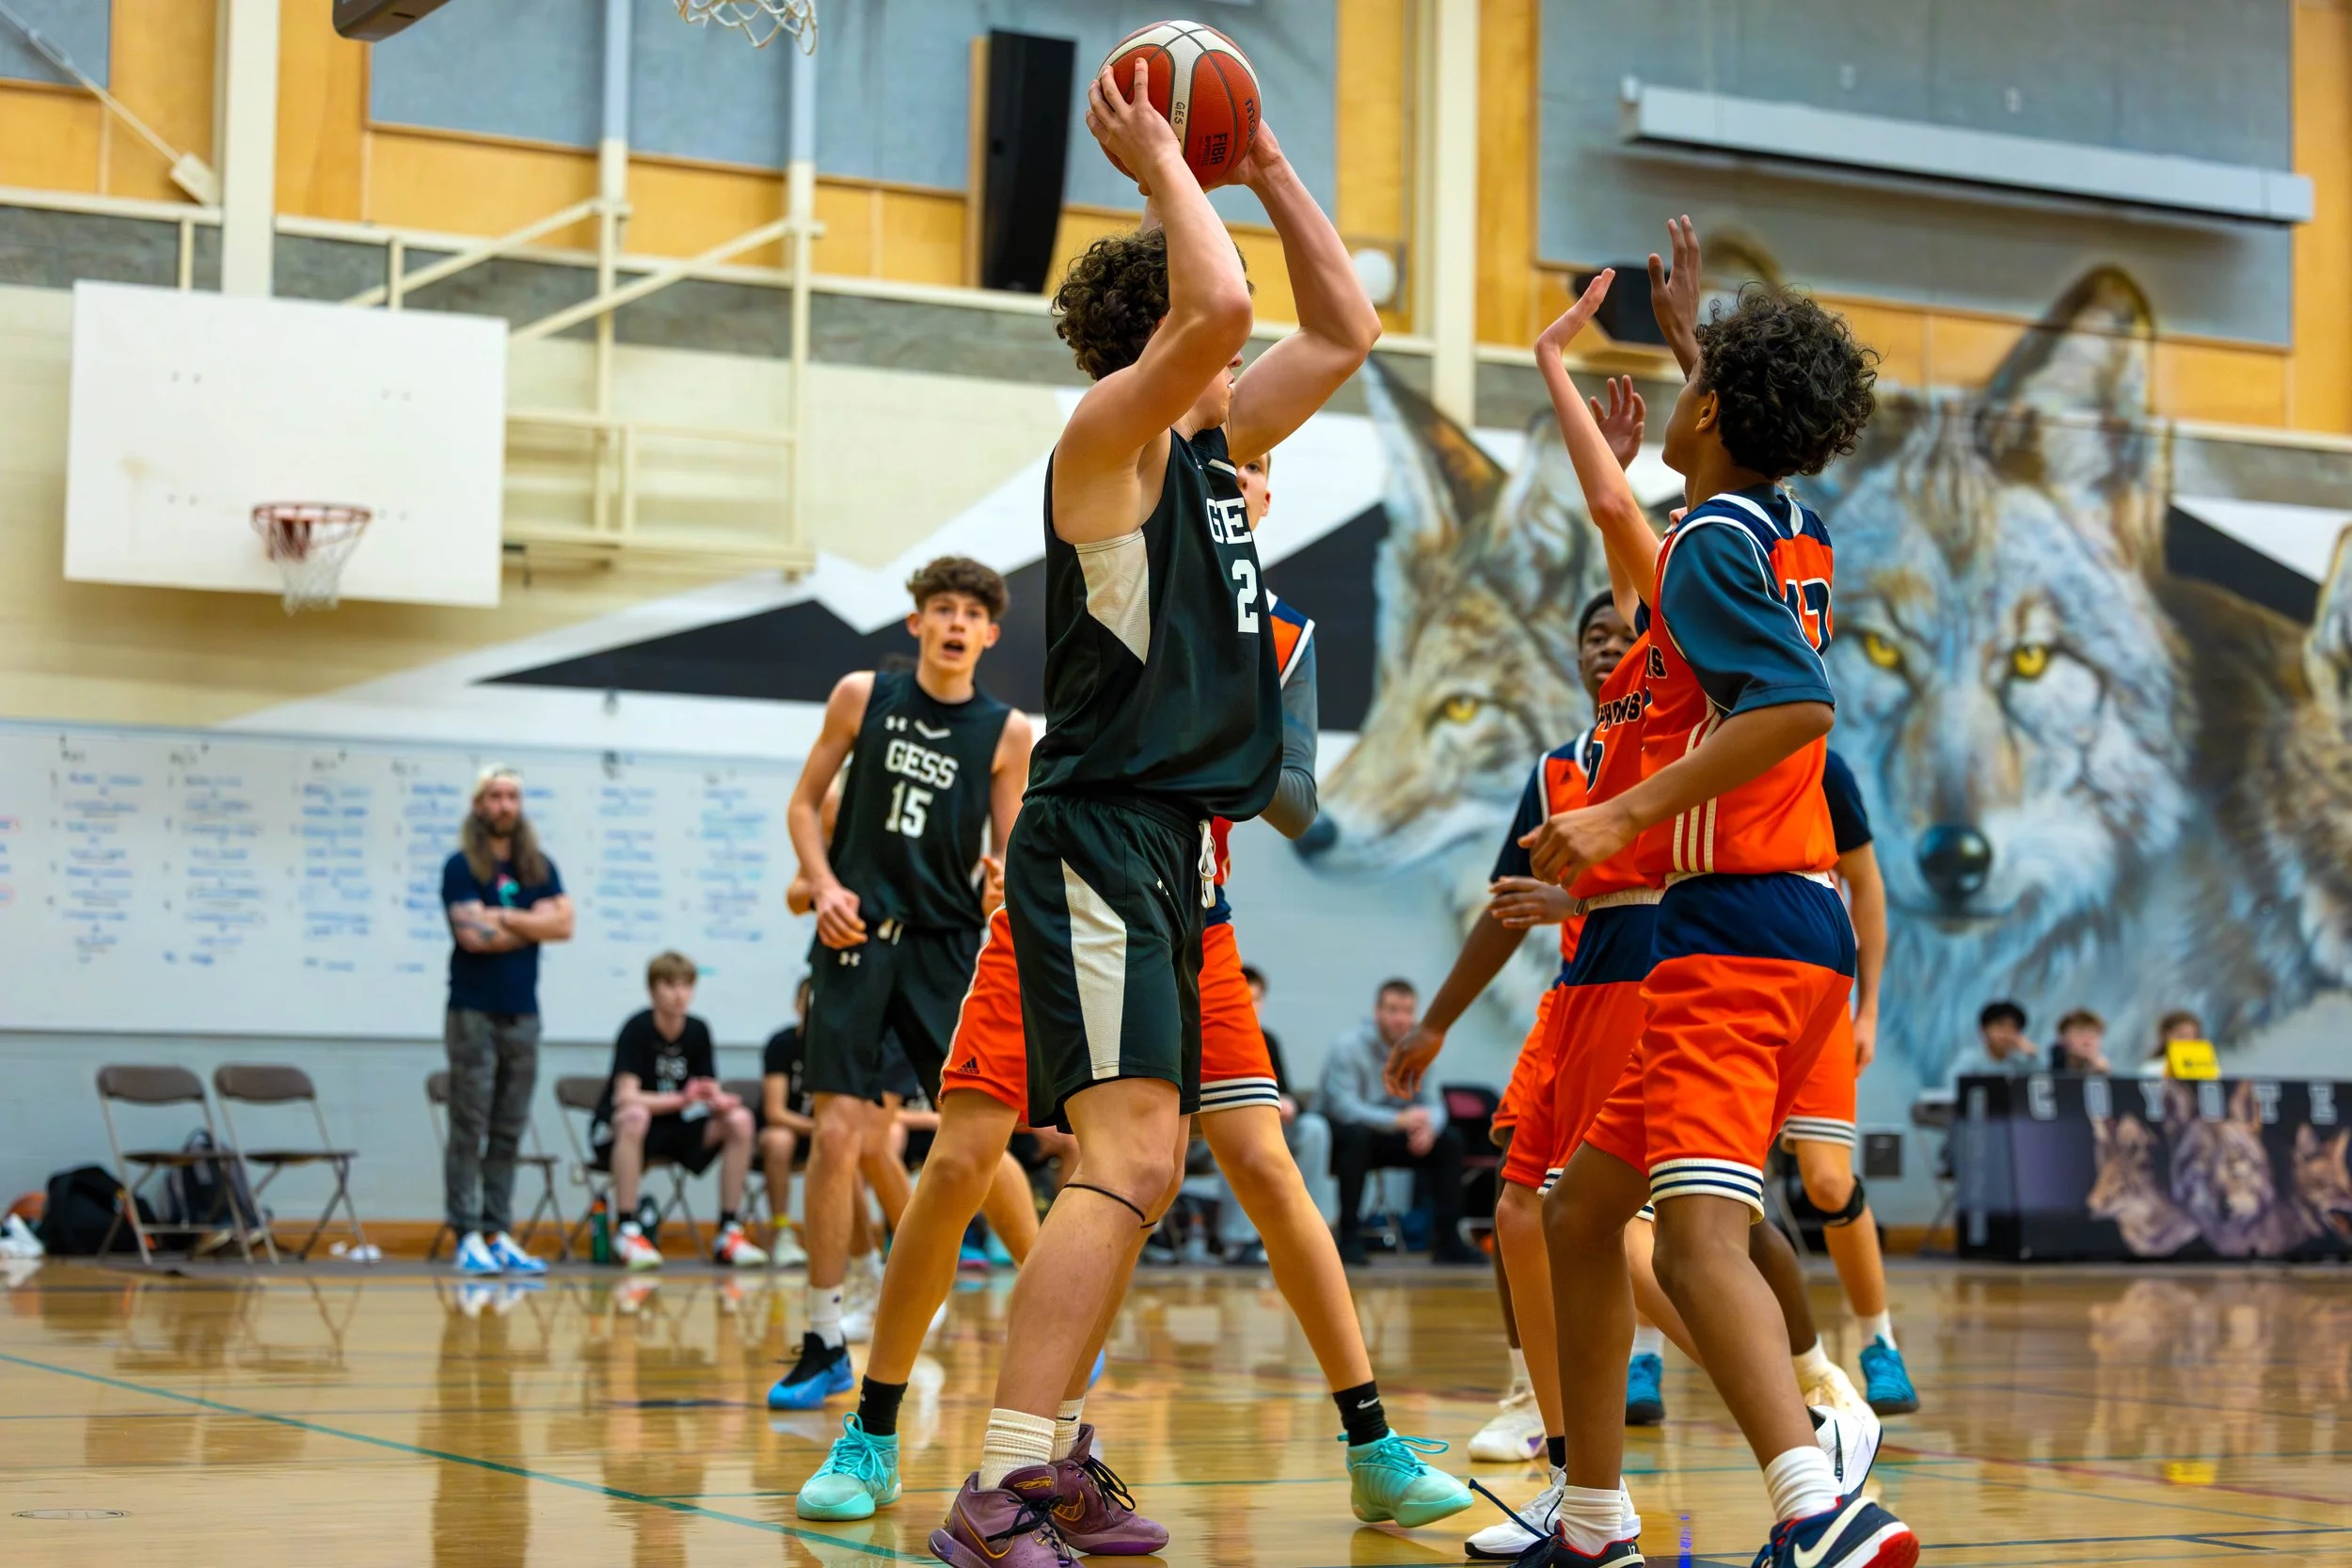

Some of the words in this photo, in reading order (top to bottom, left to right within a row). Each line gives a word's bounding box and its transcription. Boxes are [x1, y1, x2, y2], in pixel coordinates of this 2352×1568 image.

[1210, 133, 1228, 165] FIBA
[1232, 560, 1259, 634] 2
[885, 738, 959, 790] GESS
[885, 780, 933, 839] 15
